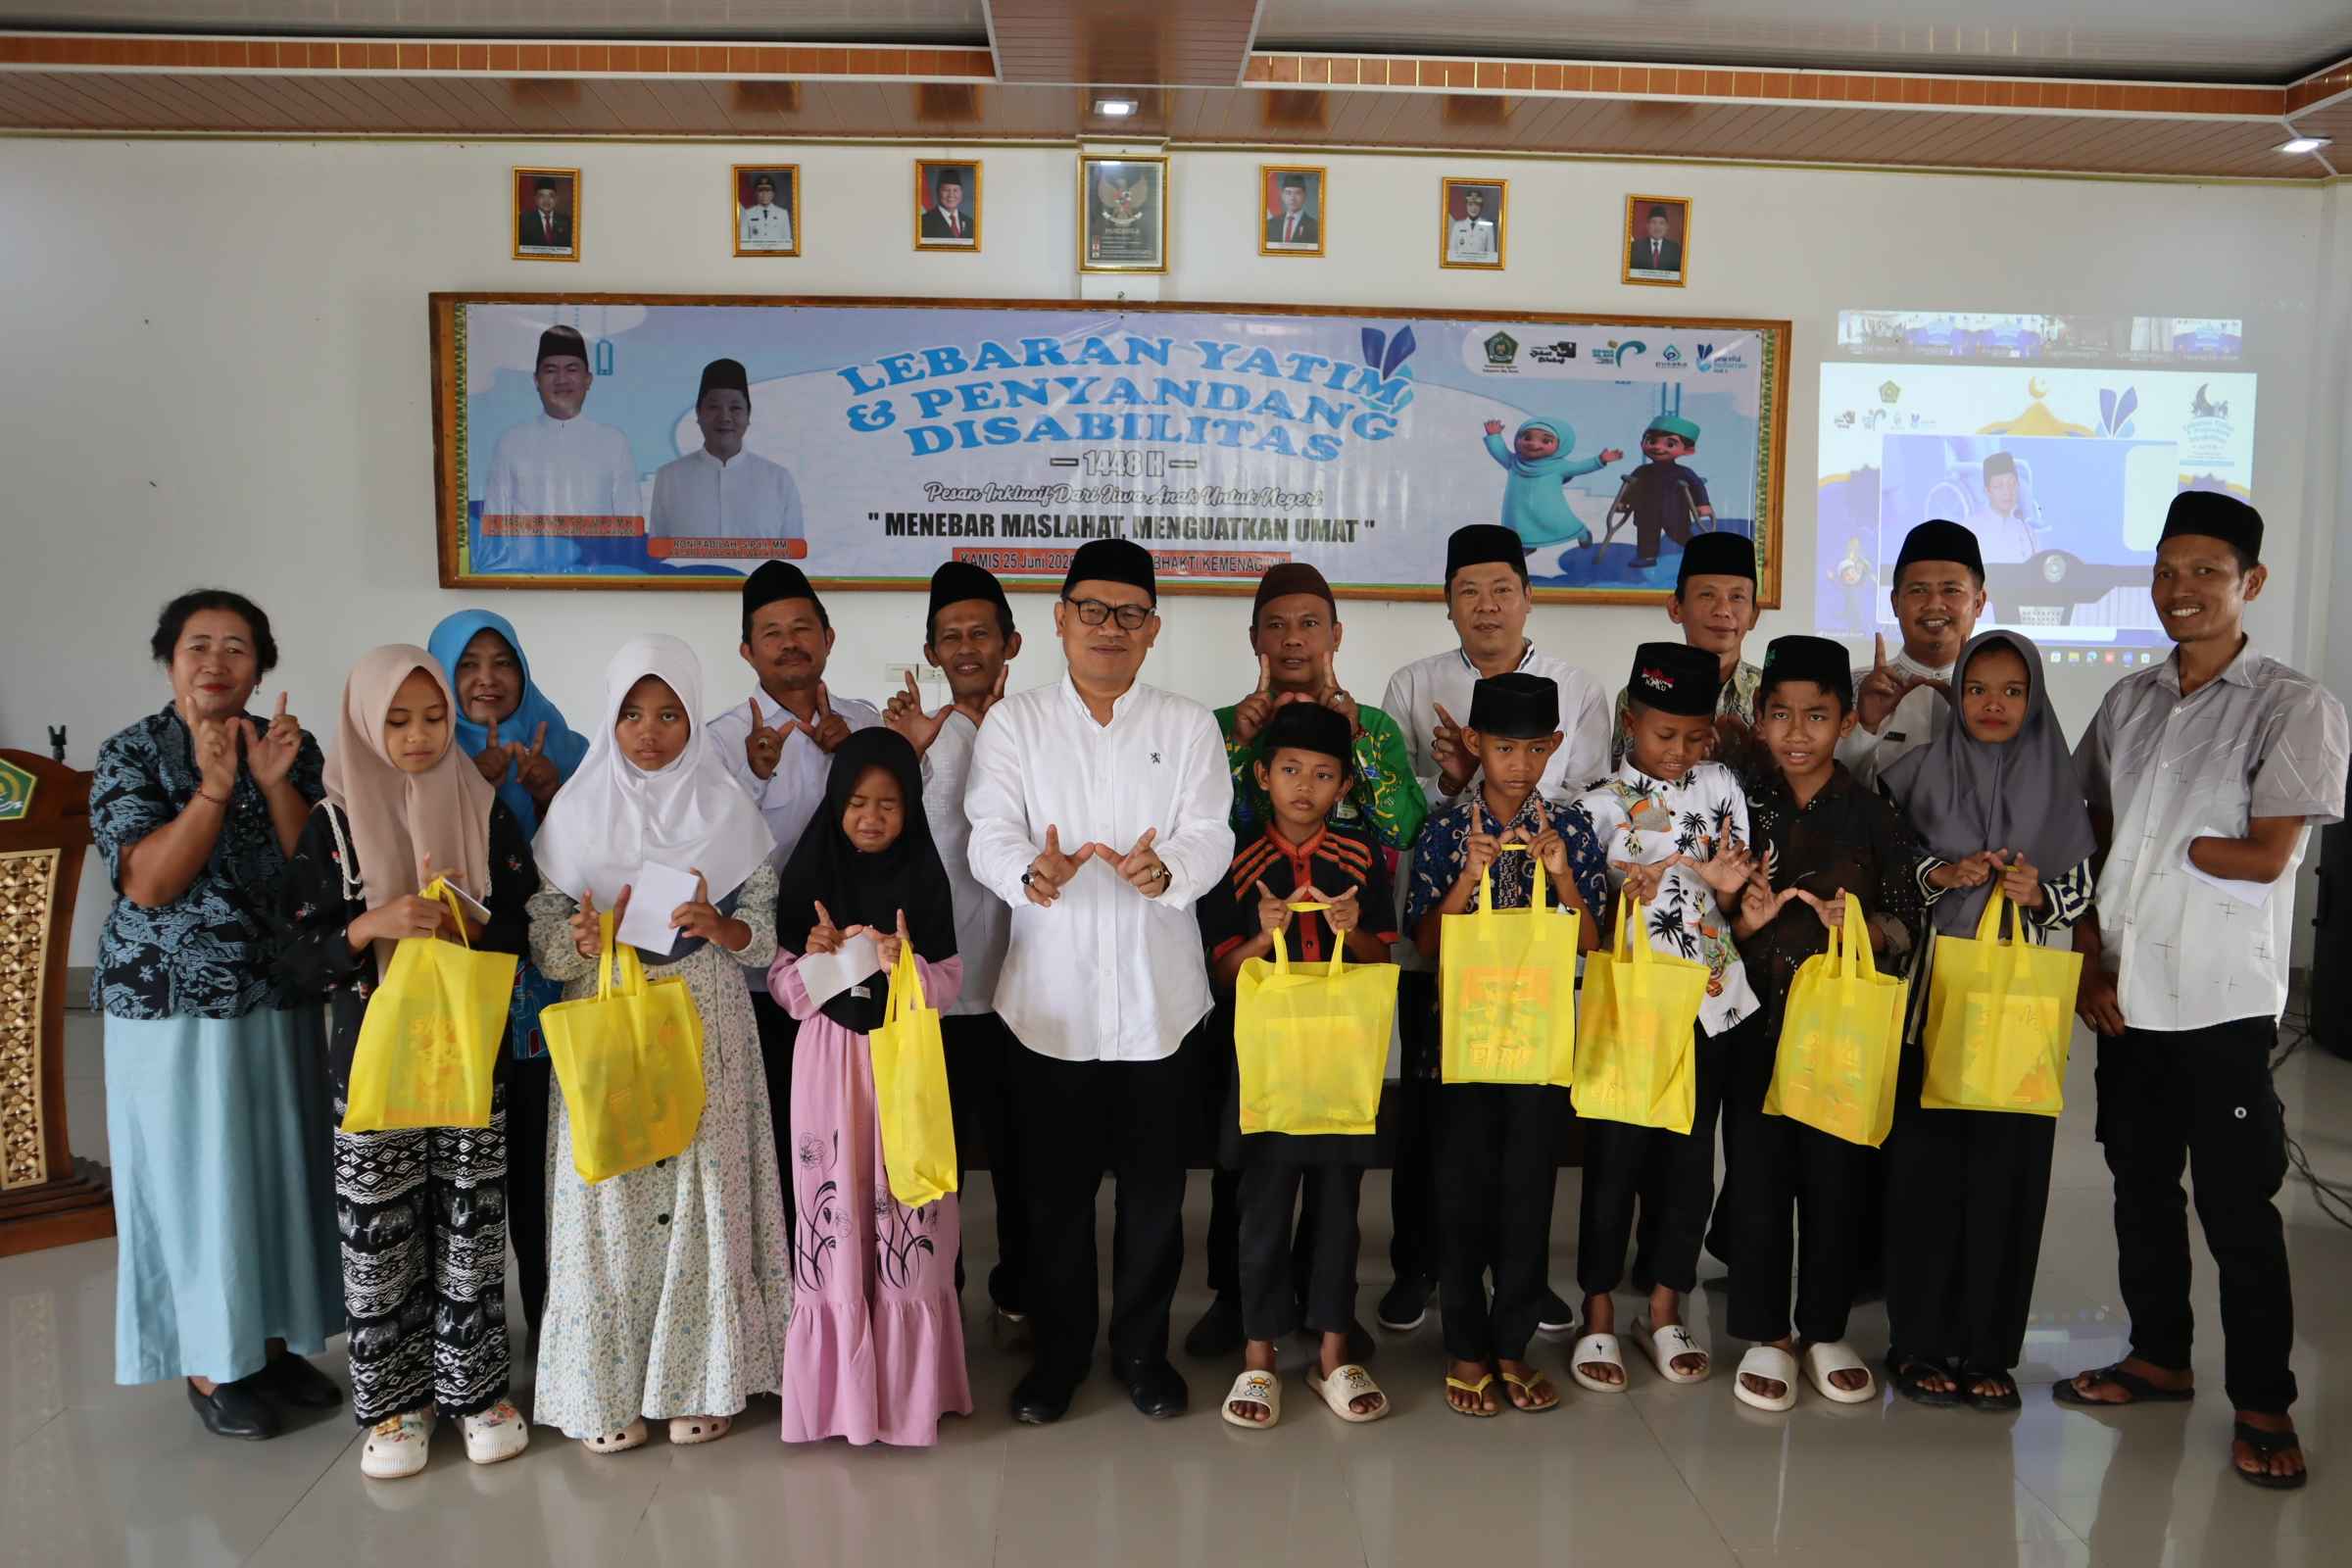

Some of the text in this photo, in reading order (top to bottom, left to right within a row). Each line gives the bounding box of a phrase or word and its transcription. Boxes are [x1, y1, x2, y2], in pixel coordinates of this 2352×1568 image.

[837, 336, 1409, 406] LEBARAN YATIM
[846, 375, 1398, 441] & PENYANDANG
[904, 412, 1343, 462] DISABILITAS
[1082, 450, 1165, 477] 1448 H
[924, 481, 1324, 512] Pesan Inklusif Dari Jiwa Anak Untuk Negeri
[885, 513, 995, 537] MENEBAR
[1132, 515, 1289, 543] MENGUATKAN
[1295, 518, 1359, 543] UMAT
[960, 553, 1001, 568] KAMIS
[1004, 553, 1018, 568] 25
[1020, 554, 1046, 568] Juni
